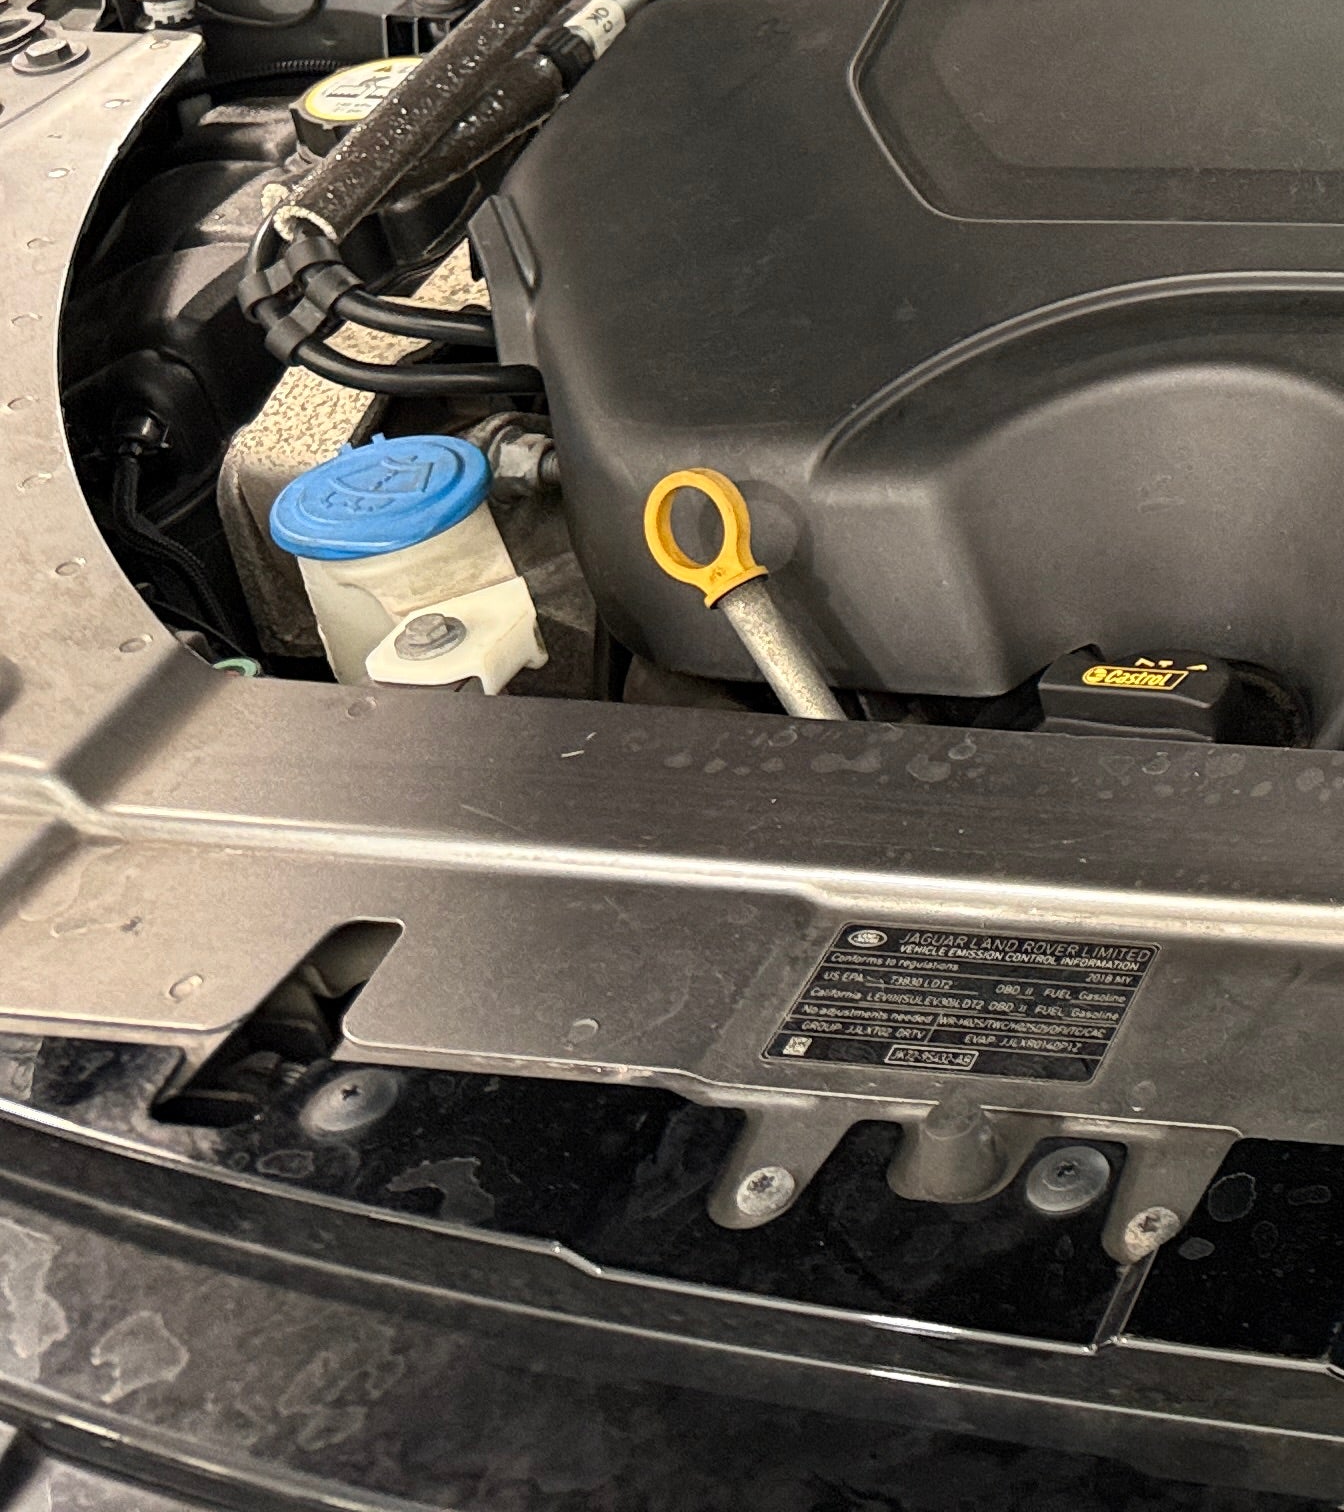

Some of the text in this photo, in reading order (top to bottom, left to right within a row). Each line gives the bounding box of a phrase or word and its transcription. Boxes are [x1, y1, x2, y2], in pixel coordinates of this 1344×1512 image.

[1104, 669, 1173, 686] Castrol
[899, 932, 968, 948] JAGUAR
[970, 937, 1019, 953] LAND
[1021, 941, 1082, 958] ROVER
[1081, 946, 1151, 963] LIMITED
[899, 945, 1140, 971] VEHICLE EMISSION CONTROL INFORMATION
[823, 970, 864, 983] US EPA
[830, 952, 882, 967] Conforms
[885, 957, 898, 967] to
[1085, 973, 1113, 984] 2018
[810, 986, 863, 1000] California
[995, 984, 1021, 995] OBD
[1043, 988, 1073, 1000] FUEL
[1078, 991, 1127, 1003] Gasoline
[801, 1004, 819, 1014] No
[988, 1001, 1015, 1012] OBD
[1034, 1005, 1064, 1017] FUEL
[1070, 1007, 1120, 1021] Gasoline
[801, 1020, 843, 1032] GROUP
[964, 1033, 998, 1045] EVAP
